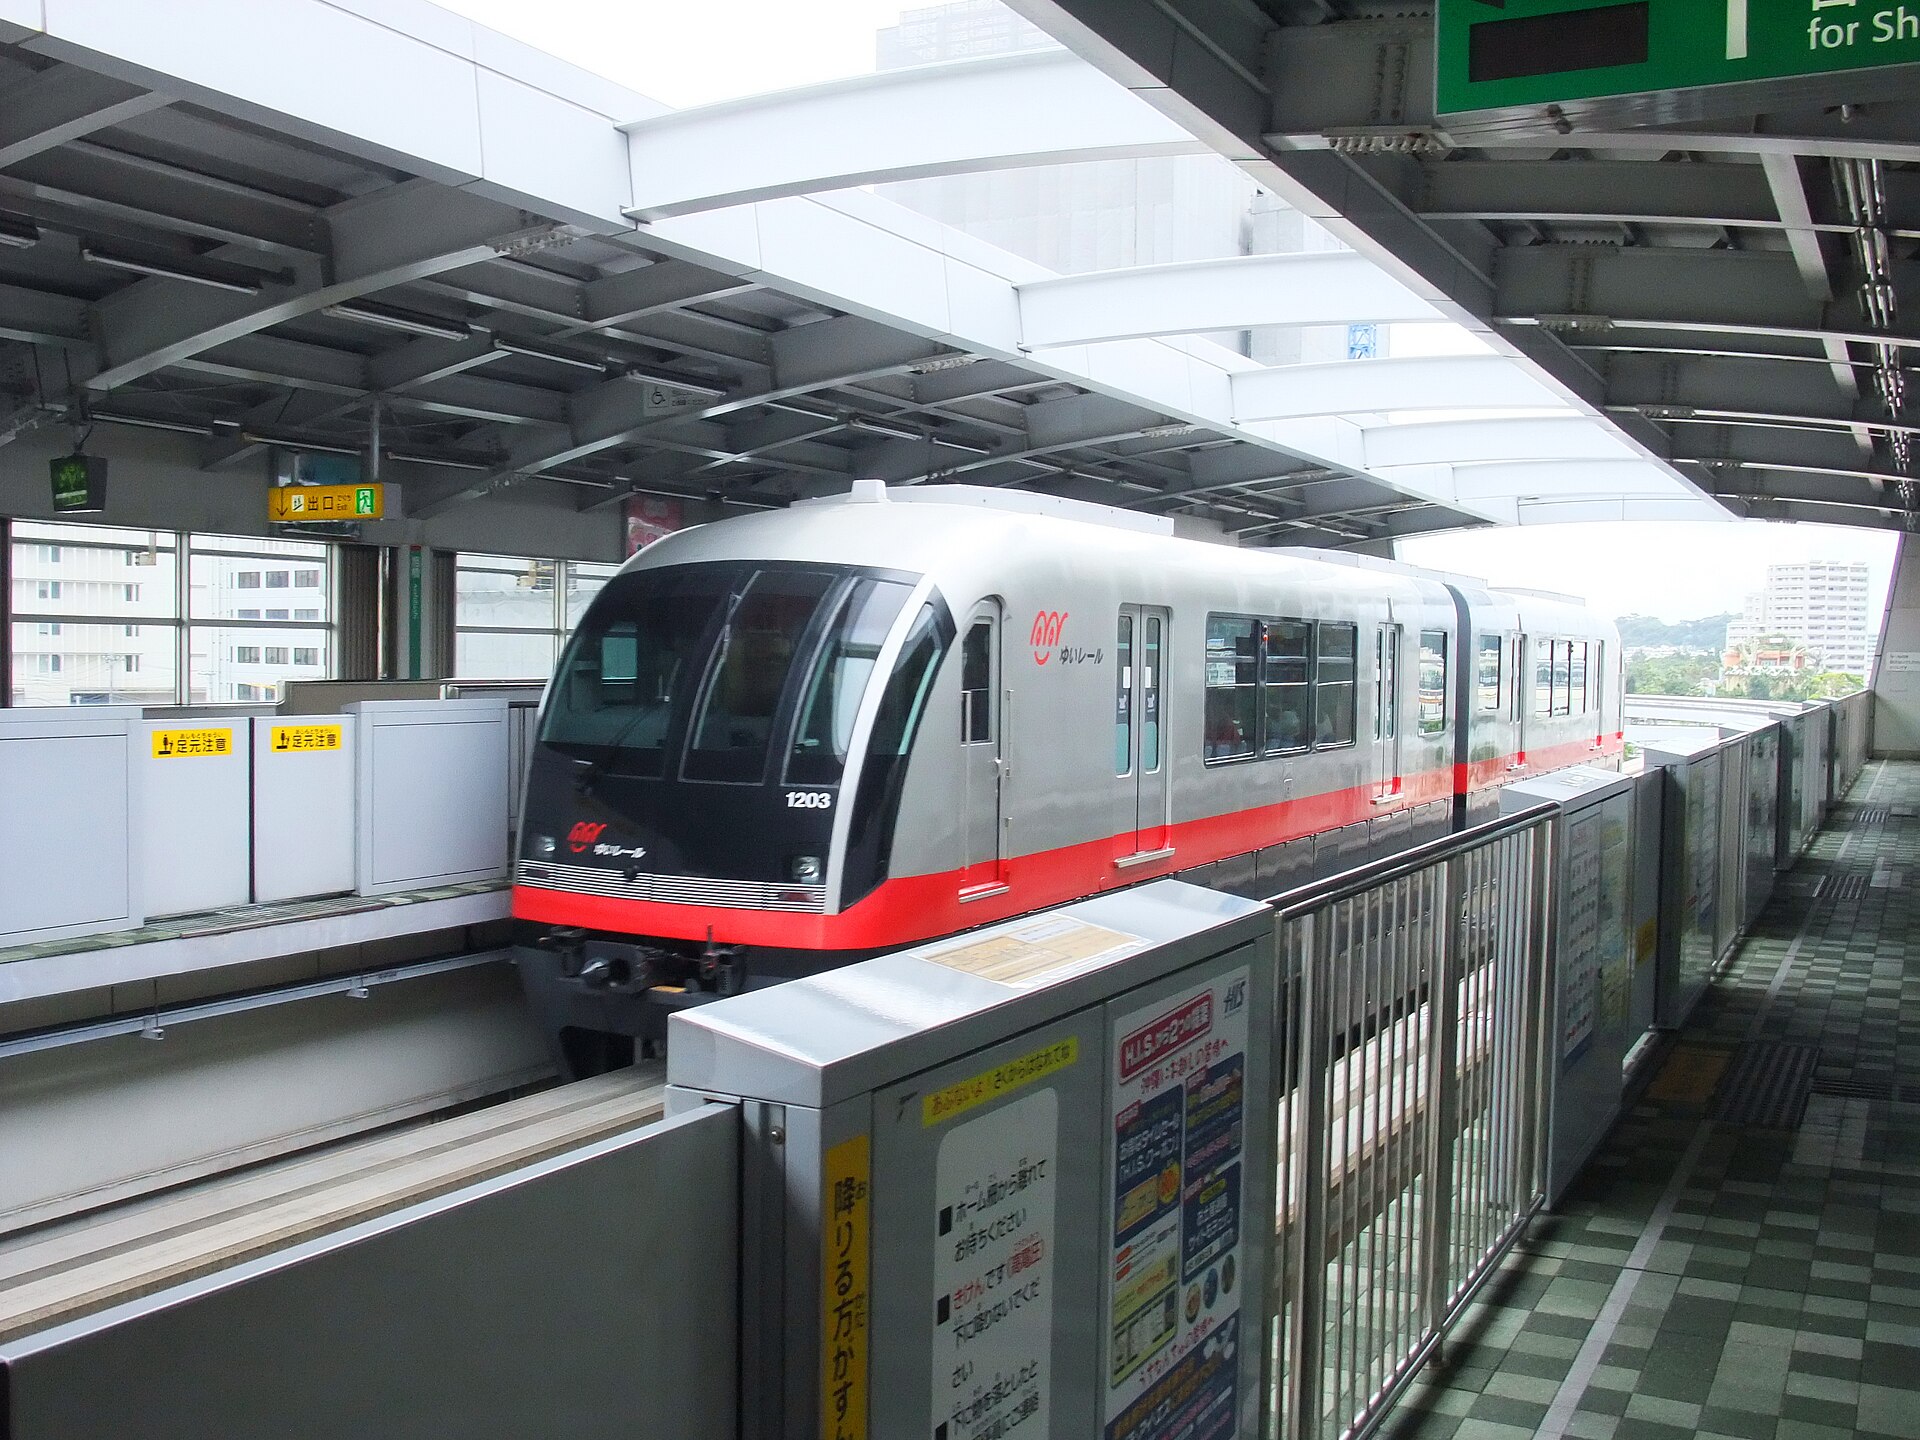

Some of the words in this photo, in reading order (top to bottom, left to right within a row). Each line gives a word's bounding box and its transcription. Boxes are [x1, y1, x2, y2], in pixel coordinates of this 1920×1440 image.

[1807, 17, 1859, 50] for
[1872, 6, 1919, 42] Sh
[308, 496, 334, 510] 出口
[1059, 646, 1104, 665] ゆいレール
[176, 738, 227, 753] 足元注意
[292, 734, 337, 748] 足元注意
[785, 792, 831, 809] 1203
[593, 843, 647, 858] ゆいレール
[954, 1207, 1027, 1263] お待ちください
[952, 1361, 975, 1389] さい
